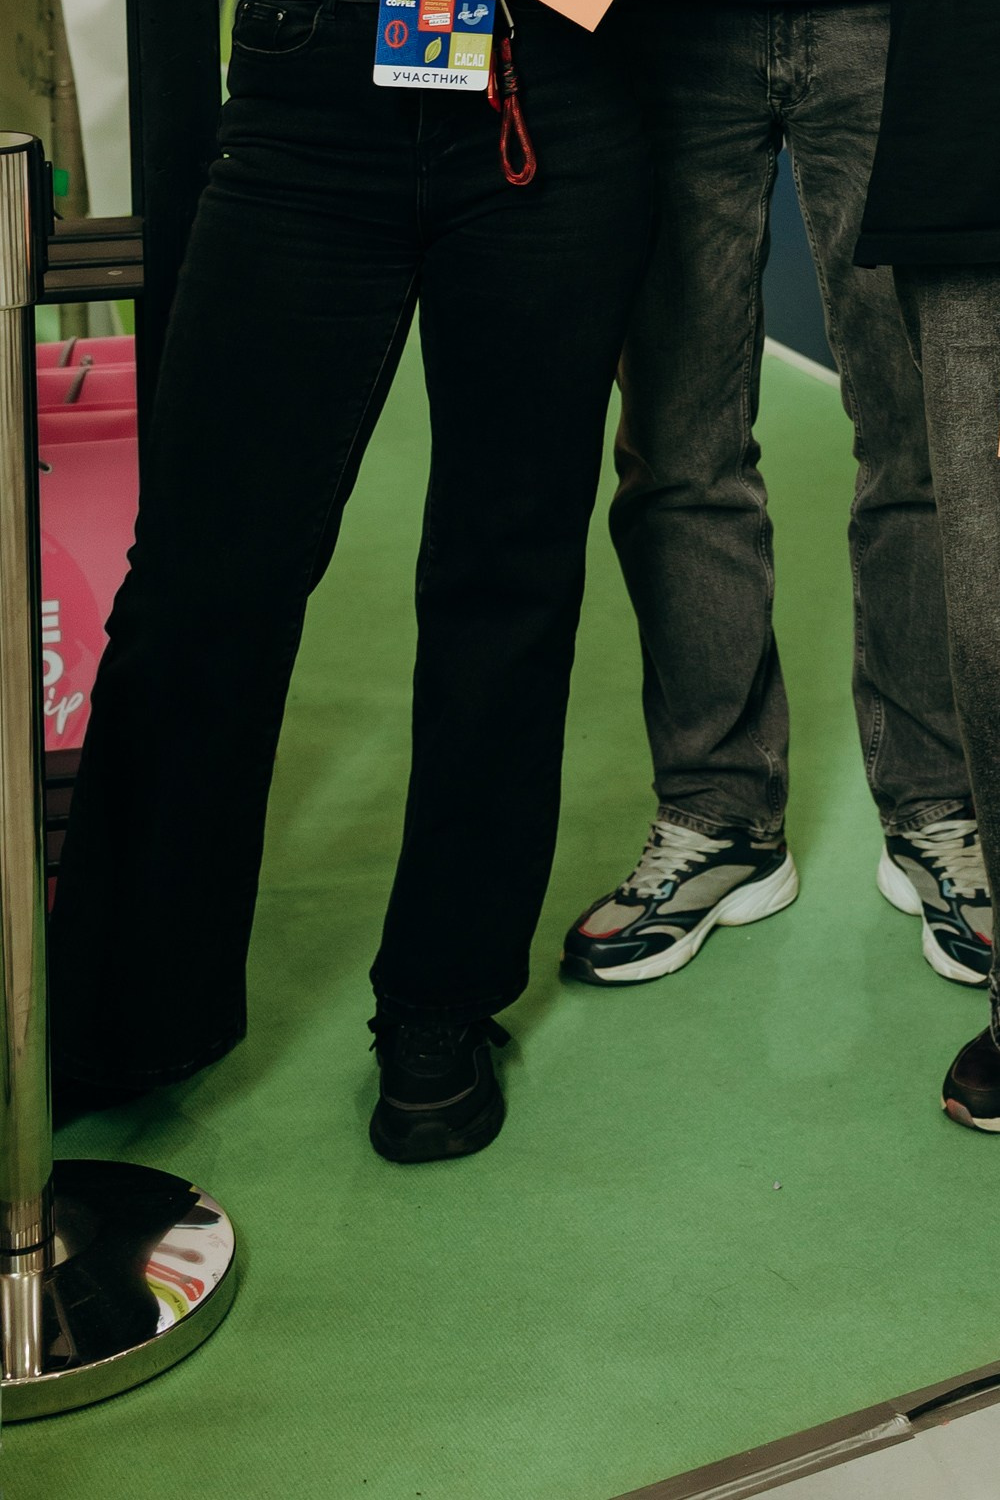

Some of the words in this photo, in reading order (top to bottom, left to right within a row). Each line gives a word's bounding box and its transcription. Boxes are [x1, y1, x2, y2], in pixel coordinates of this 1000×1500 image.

[385, 0, 416, 8] COFFEE
[454, 53, 485, 67] CACAO
[392, 71, 468, 85] УЧАСТНИК
